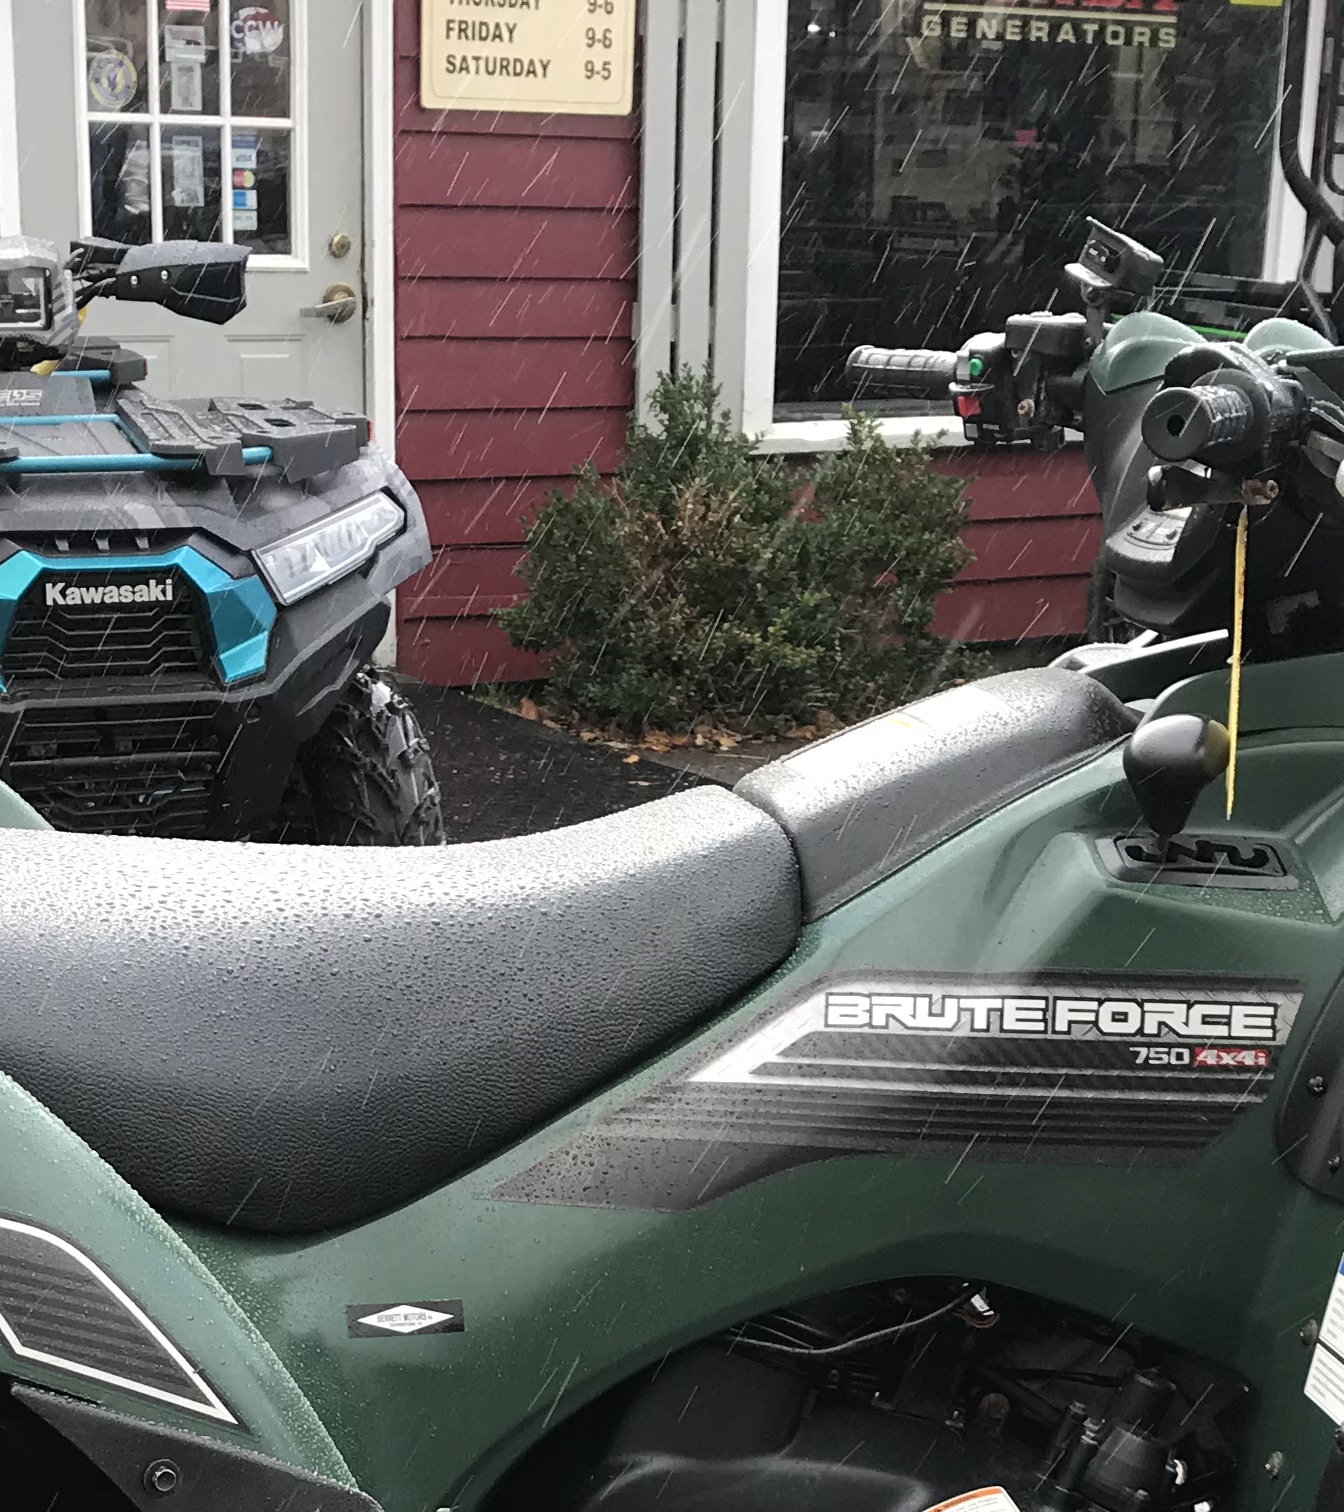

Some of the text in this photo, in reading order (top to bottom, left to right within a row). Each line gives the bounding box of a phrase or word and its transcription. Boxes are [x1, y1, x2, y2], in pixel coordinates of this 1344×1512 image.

[445, 19, 613, 49] FRIDAY 9-6
[921, 15, 1177, 49] GENERATORS
[445, 54, 612, 80] SATURDAY 9-5
[45, 579, 173, 606] Kawasaki
[825, 993, 1276, 1041] BRUTE FORCE
[1130, 1046, 1190, 1066] 750
